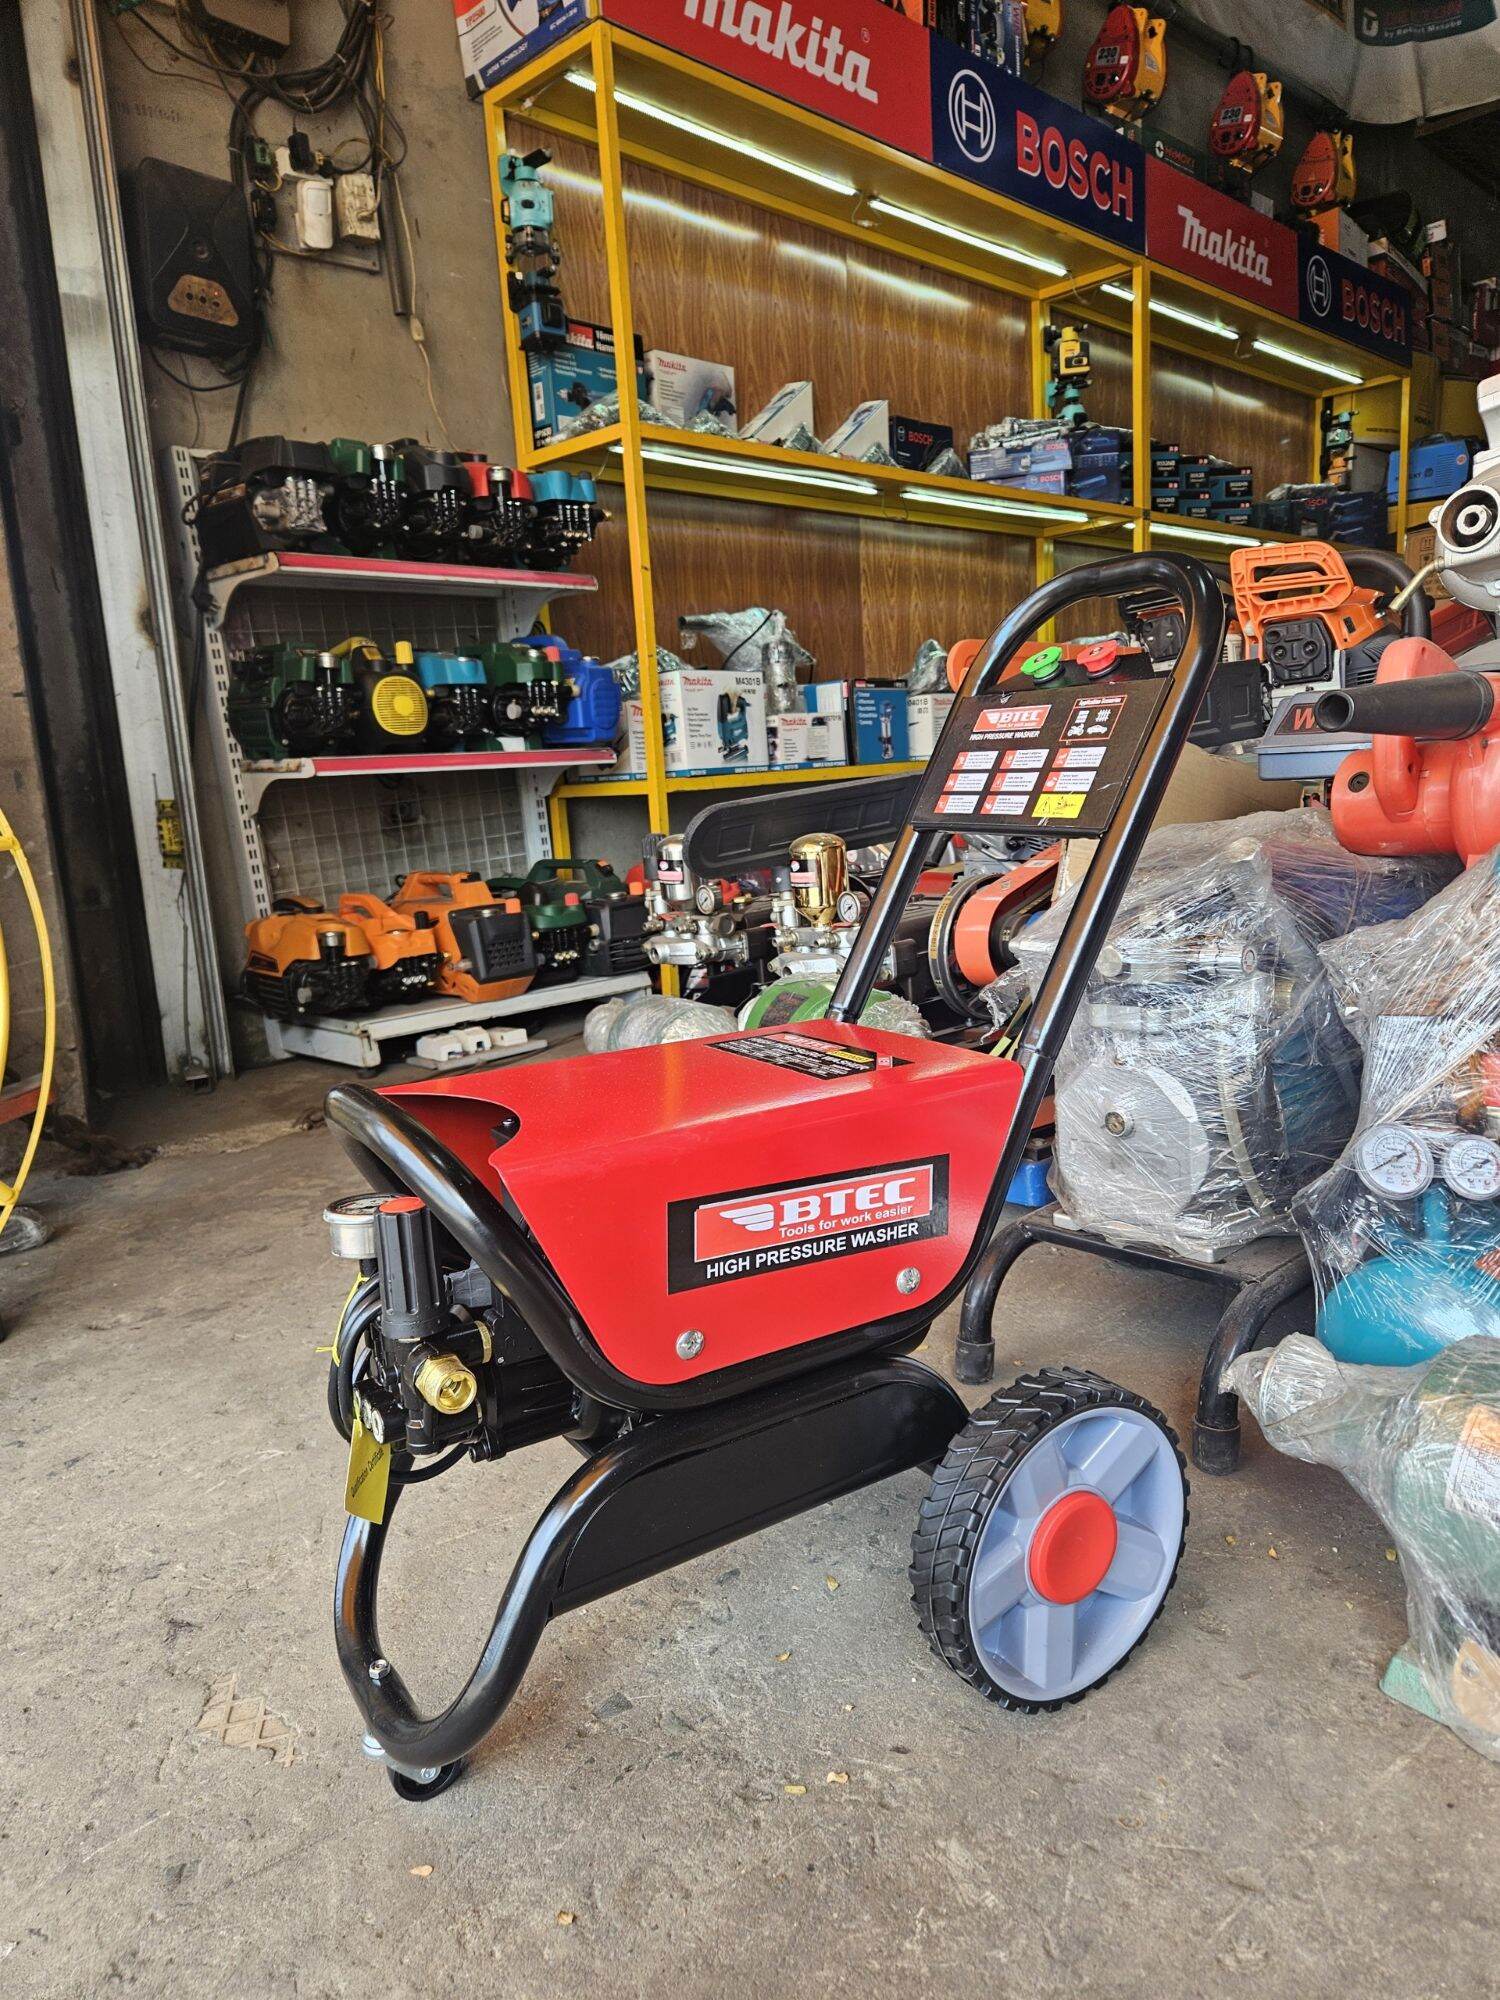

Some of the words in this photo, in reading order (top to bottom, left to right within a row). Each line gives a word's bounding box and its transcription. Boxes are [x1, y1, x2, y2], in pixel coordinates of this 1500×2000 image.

[1016, 110, 1134, 222] BOSCH
[1341, 278, 1406, 346] BOSCH
[908, 431, 933, 445] BOSCH
[1039, 474, 1061, 483] BOSCH
[969, 733, 984, 741] HIGH
[984, 732, 1015, 741] PRESSURE
[779, 1177, 916, 1226] BTEC
[779, 1222, 816, 1239] Tools
[818, 1217, 837, 1231] for
[840, 1212, 872, 1227] work
[875, 1204, 913, 1220] easier
[706, 1255, 751, 1279] HIGH
[755, 1235, 848, 1269] PRESSURE
[850, 1222, 919, 1249] WASHER
